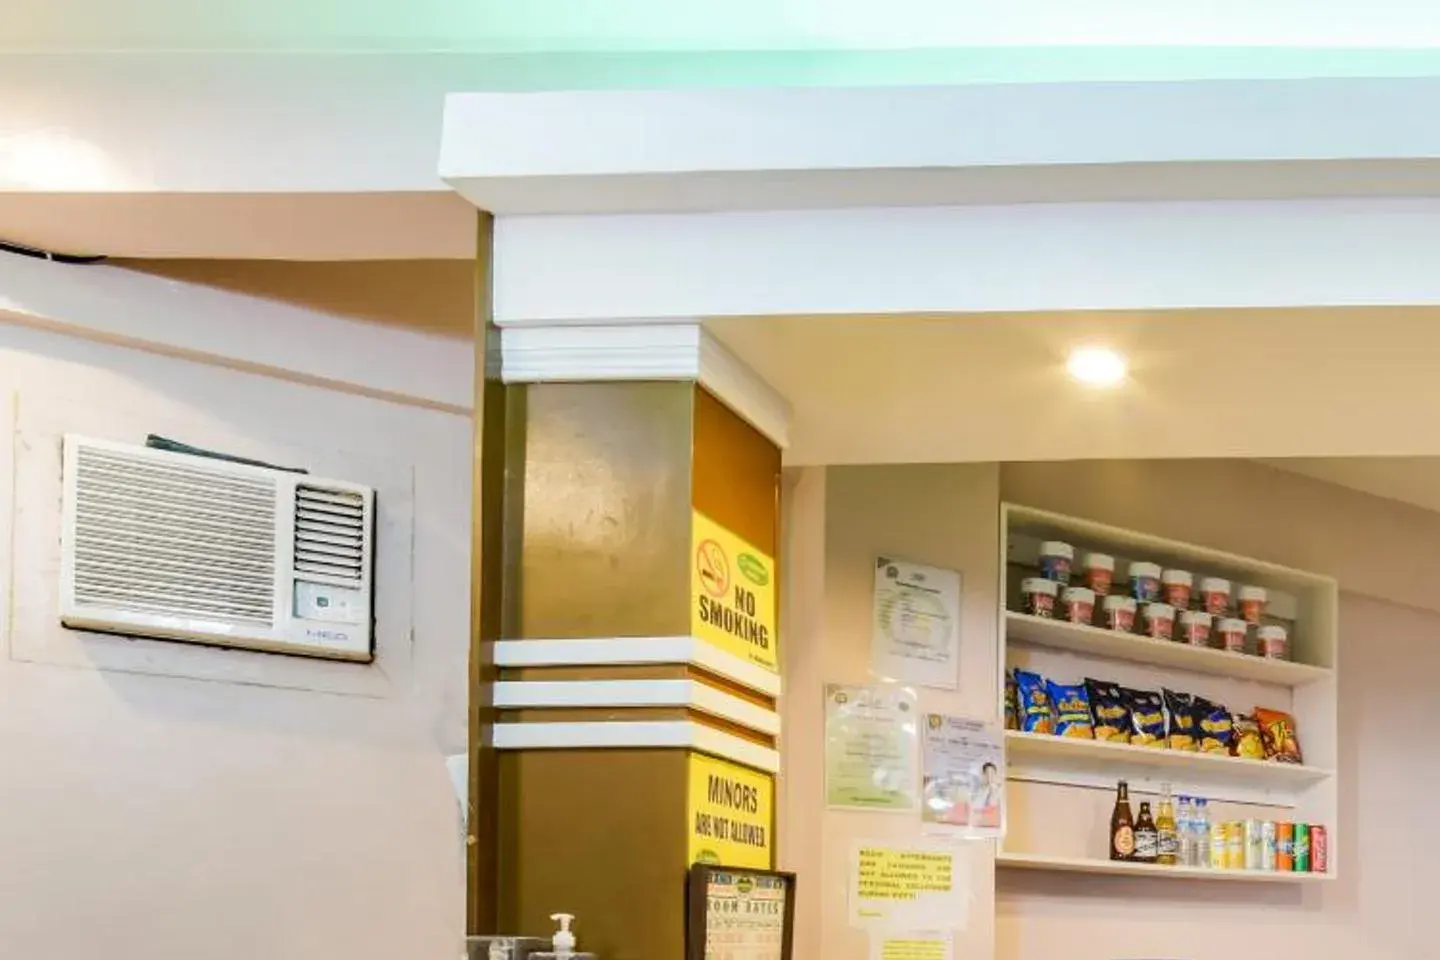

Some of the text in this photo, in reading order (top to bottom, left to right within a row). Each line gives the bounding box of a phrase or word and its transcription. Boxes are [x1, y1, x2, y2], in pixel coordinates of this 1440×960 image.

[735, 585, 756, 617] NO
[698, 594, 769, 649] SMOKING
[707, 774, 758, 813] MINORS
[695, 811, 712, 836] ARE
[713, 816, 729, 840] NOT
